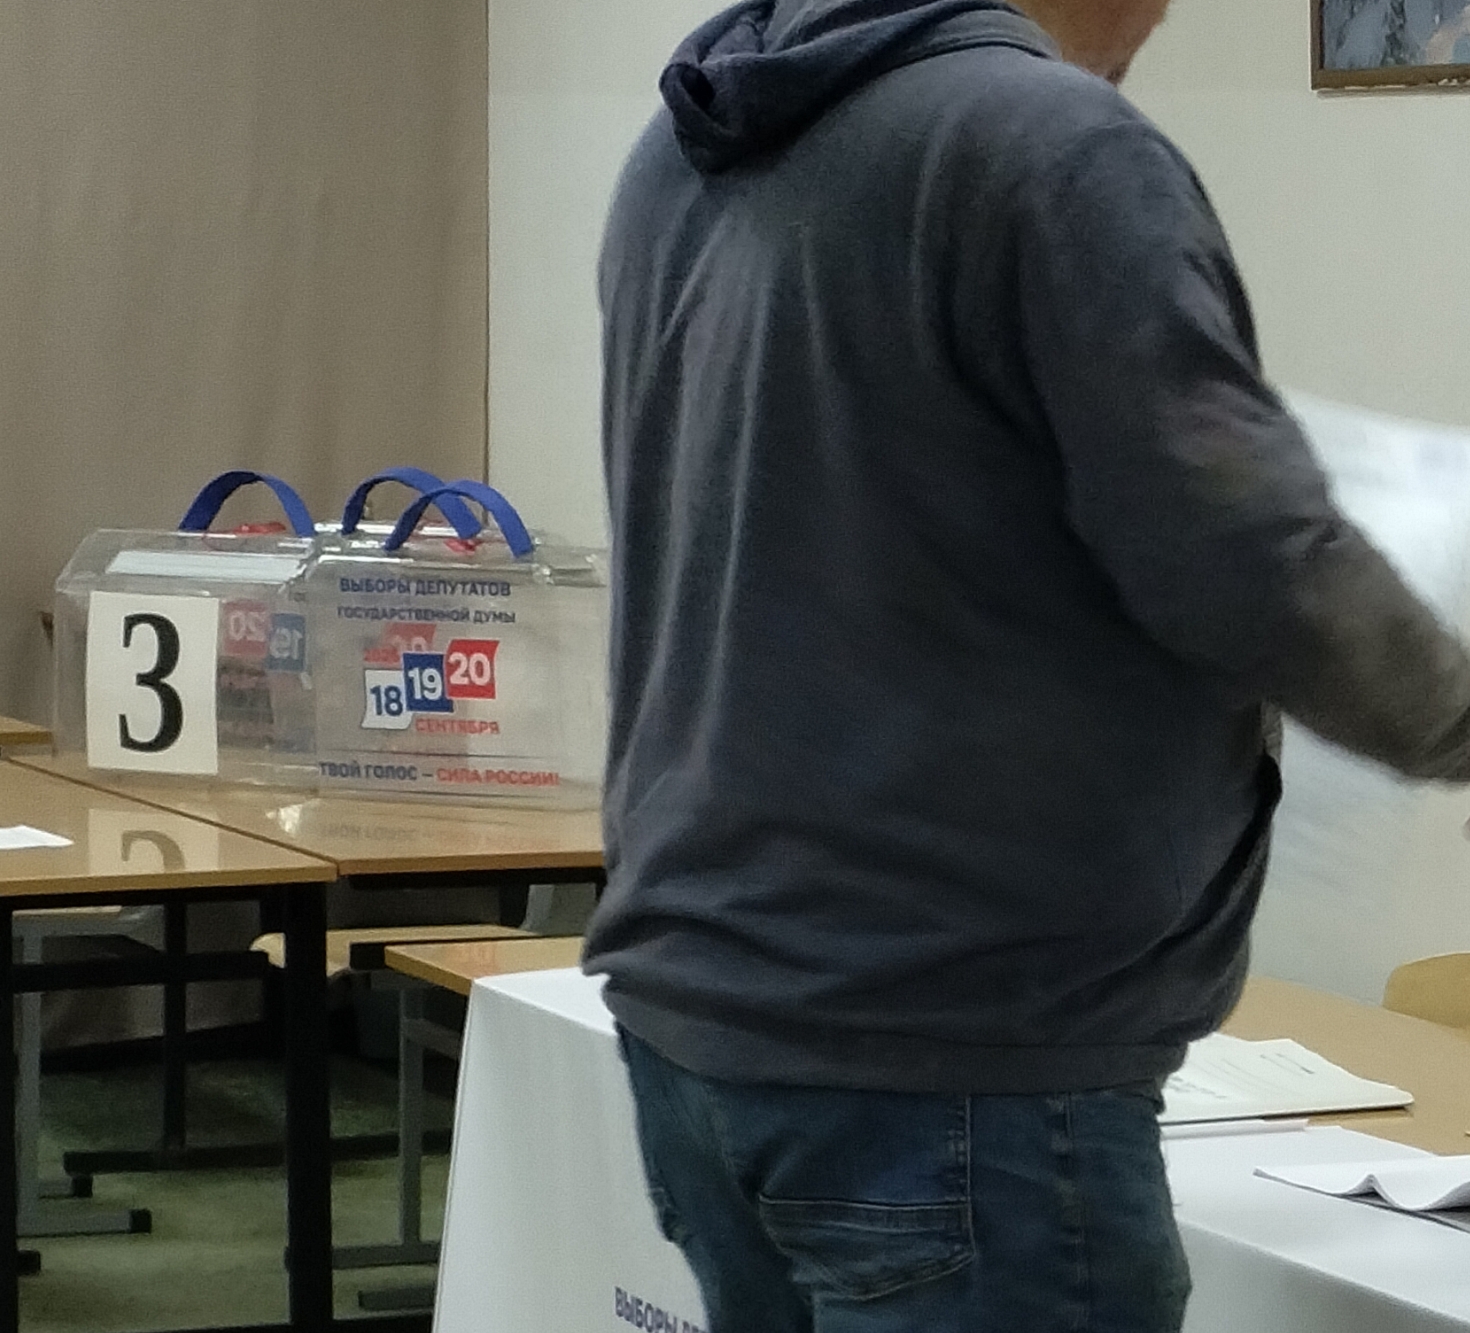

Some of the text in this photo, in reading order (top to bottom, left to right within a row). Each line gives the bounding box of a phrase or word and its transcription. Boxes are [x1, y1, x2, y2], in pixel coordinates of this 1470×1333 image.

[339, 577, 511, 597] ВЫБОРЫ ДЕПУТАТОВ
[337, 605, 516, 624] ГОСУДАРСТВЕННОЙ ДУМЫ
[118, 612, 184, 754] 3
[369, 652, 491, 717] 18 19 20
[318, 760, 361, 779] ТВОЙ
[365, 764, 417, 781] ГОЛОС
[436, 767, 483, 784] СИЛА
